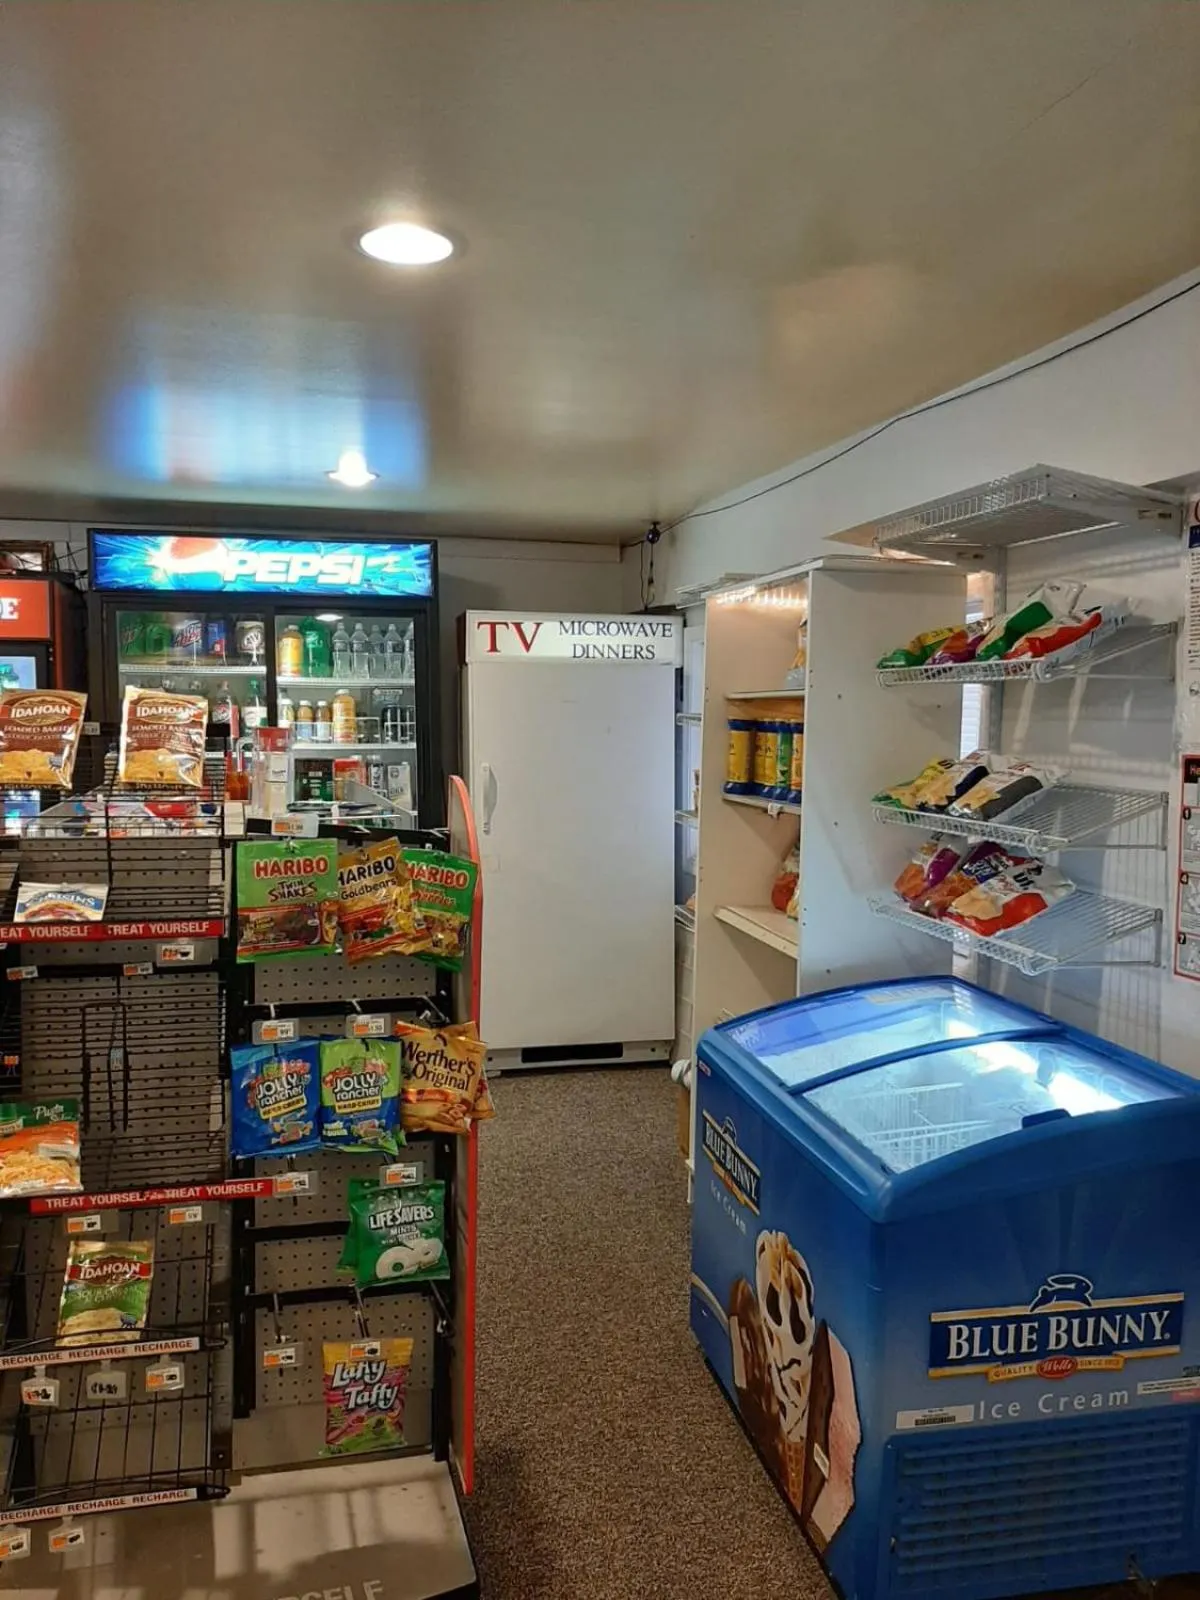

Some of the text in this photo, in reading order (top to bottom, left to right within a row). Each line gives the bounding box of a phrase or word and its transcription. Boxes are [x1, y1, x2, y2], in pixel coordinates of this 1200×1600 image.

[222, 551, 366, 585] PEPSI
[0, 597, 20, 620] E
[477, 621, 543, 654] TV
[559, 621, 673, 638] MICROWAVE
[573, 644, 656, 660] DINNERS
[11, 705, 71, 718] IDAHOAN
[136, 706, 195, 718] IDAHOAN
[254, 855, 329, 878] HARIBO
[341, 877, 397, 900] Goldbears
[29, 924, 90, 938] YOURSELF
[150, 921, 209, 934] YOURSELF
[401, 1039, 477, 1077] Werther's
[257, 1073, 298, 1099] JOLLY
[334, 1072, 376, 1093] JOLLY
[412, 1061, 470, 1092] Original
[260, 1085, 302, 1107] rancher
[336, 1086, 380, 1101] rancher
[706, 1121, 757, 1201] BLUE BUNNY
[46, 1197, 84, 1209] TREAT
[206, 1183, 264, 1196] YOURSELF
[80, 1262, 140, 1279] IDAHOAN
[947, 1311, 1170, 1360] BLUE BUNNY
[1, 1340, 193, 1366] RECHARGE RECHARGE RECHARGE
[993, 1365, 1033, 1377] QUALITY
[345, 1382, 398, 1409] Taffy
[979, 1400, 1020, 1420] Ice
[1038, 1390, 1129, 1414] Cream
[1, 1507, 61, 1521] RECHARGE
[67, 1499, 125, 1512] RECHARGE
